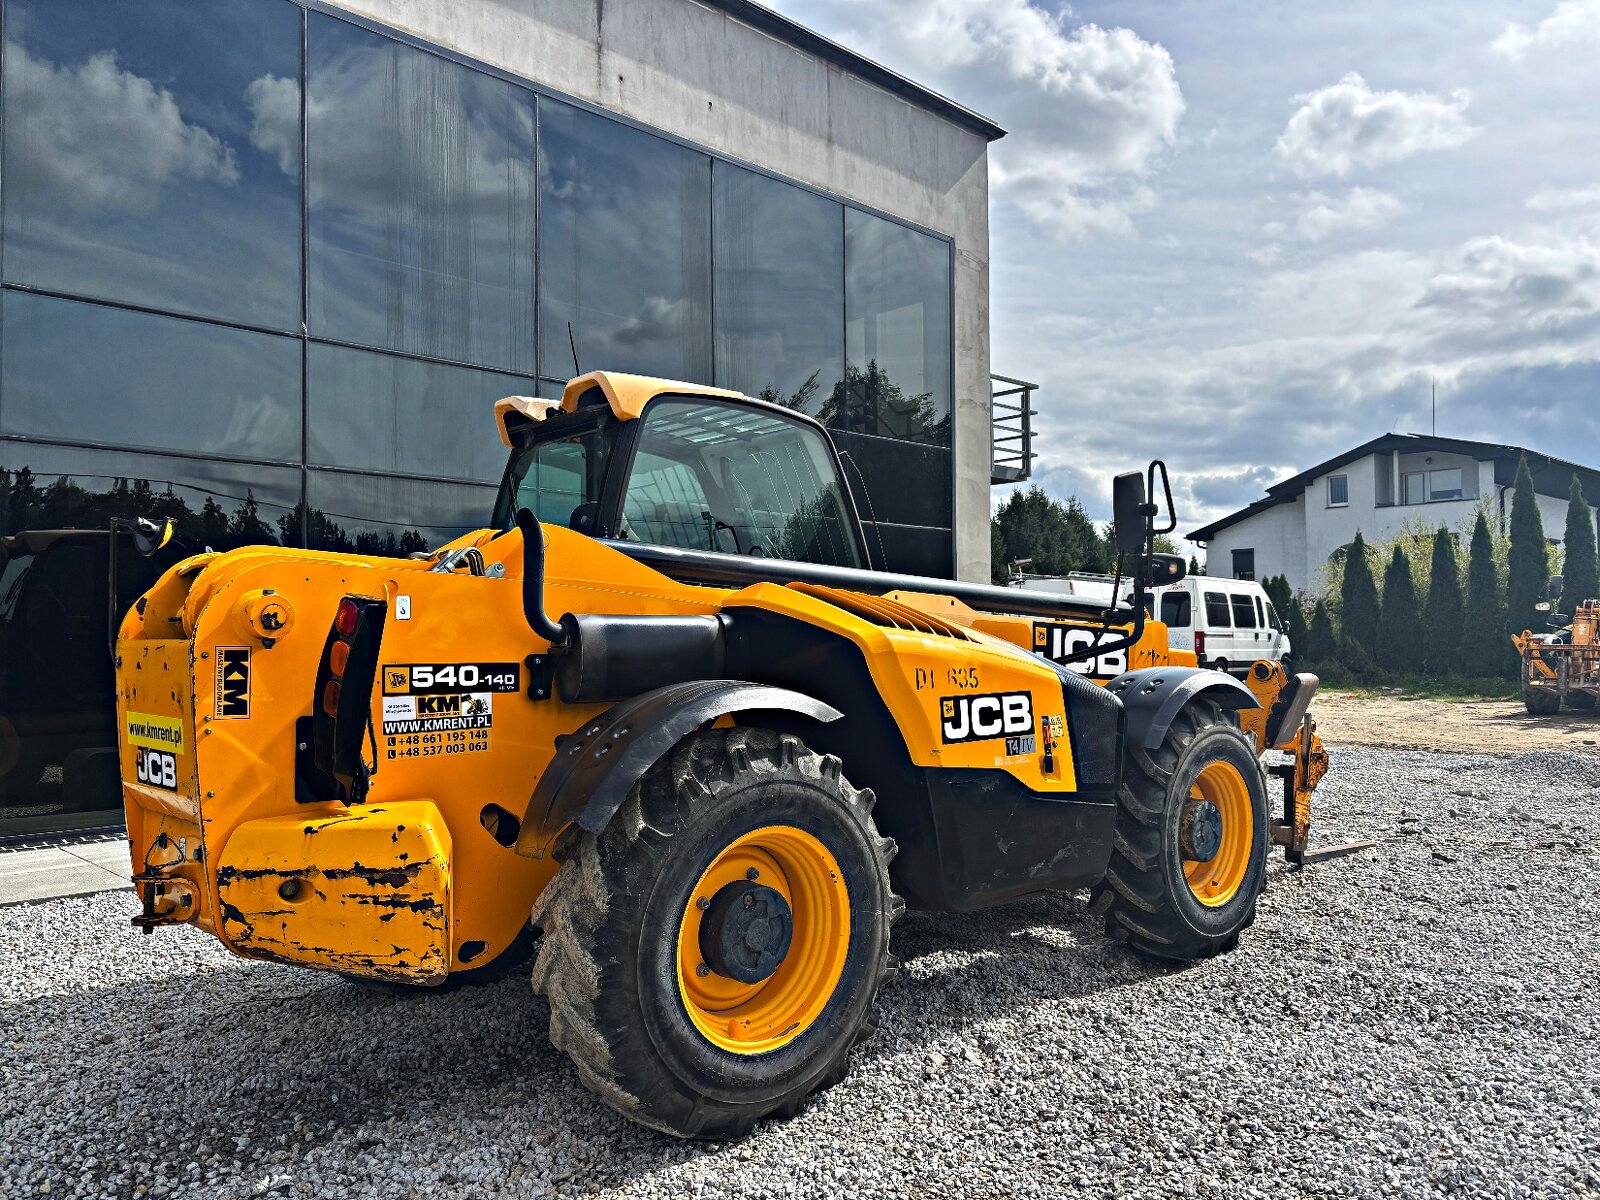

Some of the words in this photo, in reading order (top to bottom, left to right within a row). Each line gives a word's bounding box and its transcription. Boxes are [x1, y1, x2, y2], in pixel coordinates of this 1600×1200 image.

[223, 650, 248, 715] KM
[411, 665, 515, 688] 540-140
[418, 696, 459, 713] KM
[384, 716, 491, 734] WWW.KMRENT.PL
[943, 695, 1032, 739] JCB
[128, 722, 182, 748] www.kmrent.pl
[398, 735, 420, 746] +48
[422, 733, 442, 744] 661
[446, 731, 466, 742] 195
[469, 730, 488, 740] 148
[398, 747, 420, 759] +48
[423, 745, 443, 756] 537
[446, 743, 466, 754] 003
[469, 741, 488, 752] 063
[138, 750, 176, 788] JCB
